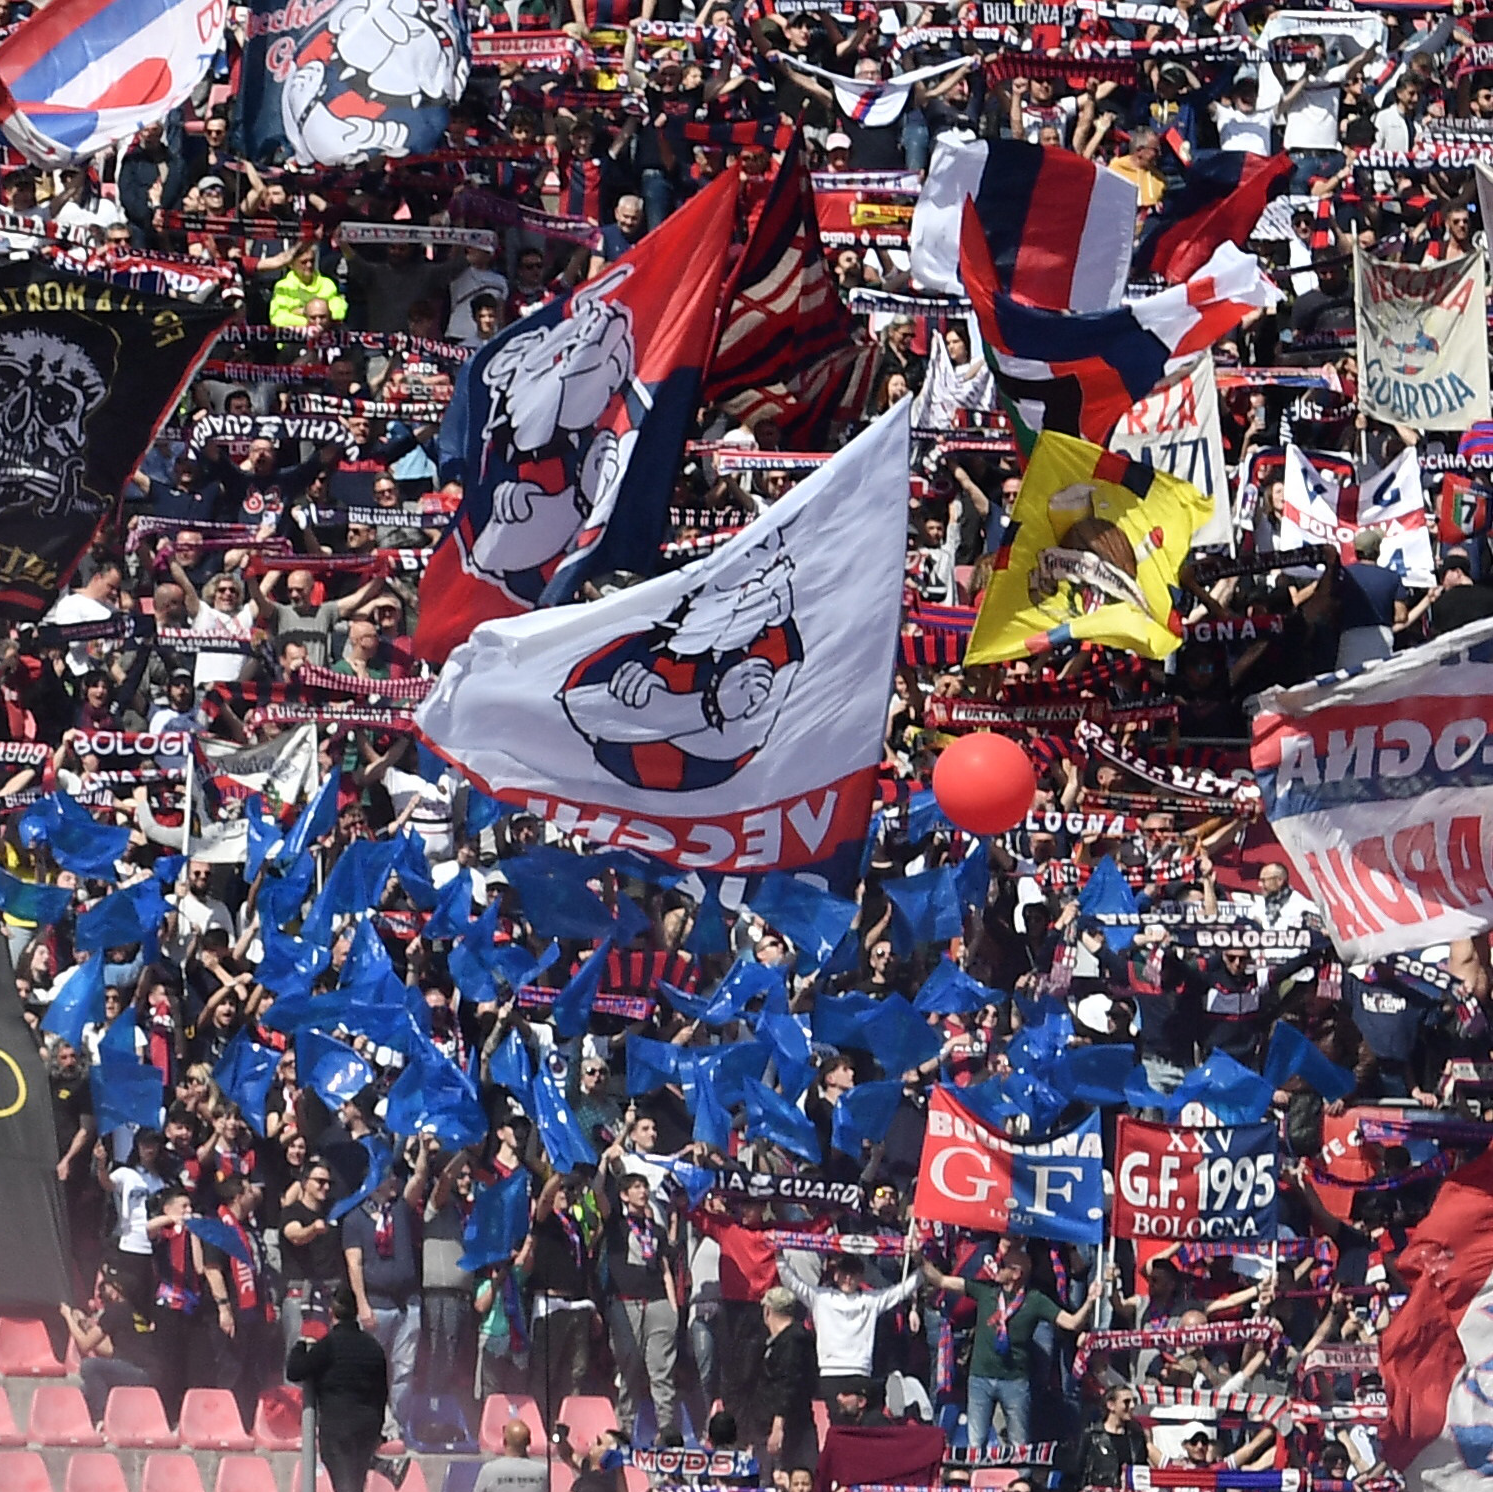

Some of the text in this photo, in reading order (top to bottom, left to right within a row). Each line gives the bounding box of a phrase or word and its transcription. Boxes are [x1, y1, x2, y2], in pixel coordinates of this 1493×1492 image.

[1363, 358, 1475, 420] GUARDIA
[1126, 378, 1199, 437] RZA
[1025, 811, 1126, 836] LOGNA
[1196, 928, 1311, 951] BOLOGNA
[1397, 954, 1445, 986] 2002
[1165, 1127, 1231, 1155] XXV
[1119, 1149, 1273, 1212] G.F. 1995
[1131, 1211, 1259, 1240] BOLOGNA
[631, 1448, 734, 1478] MODS
